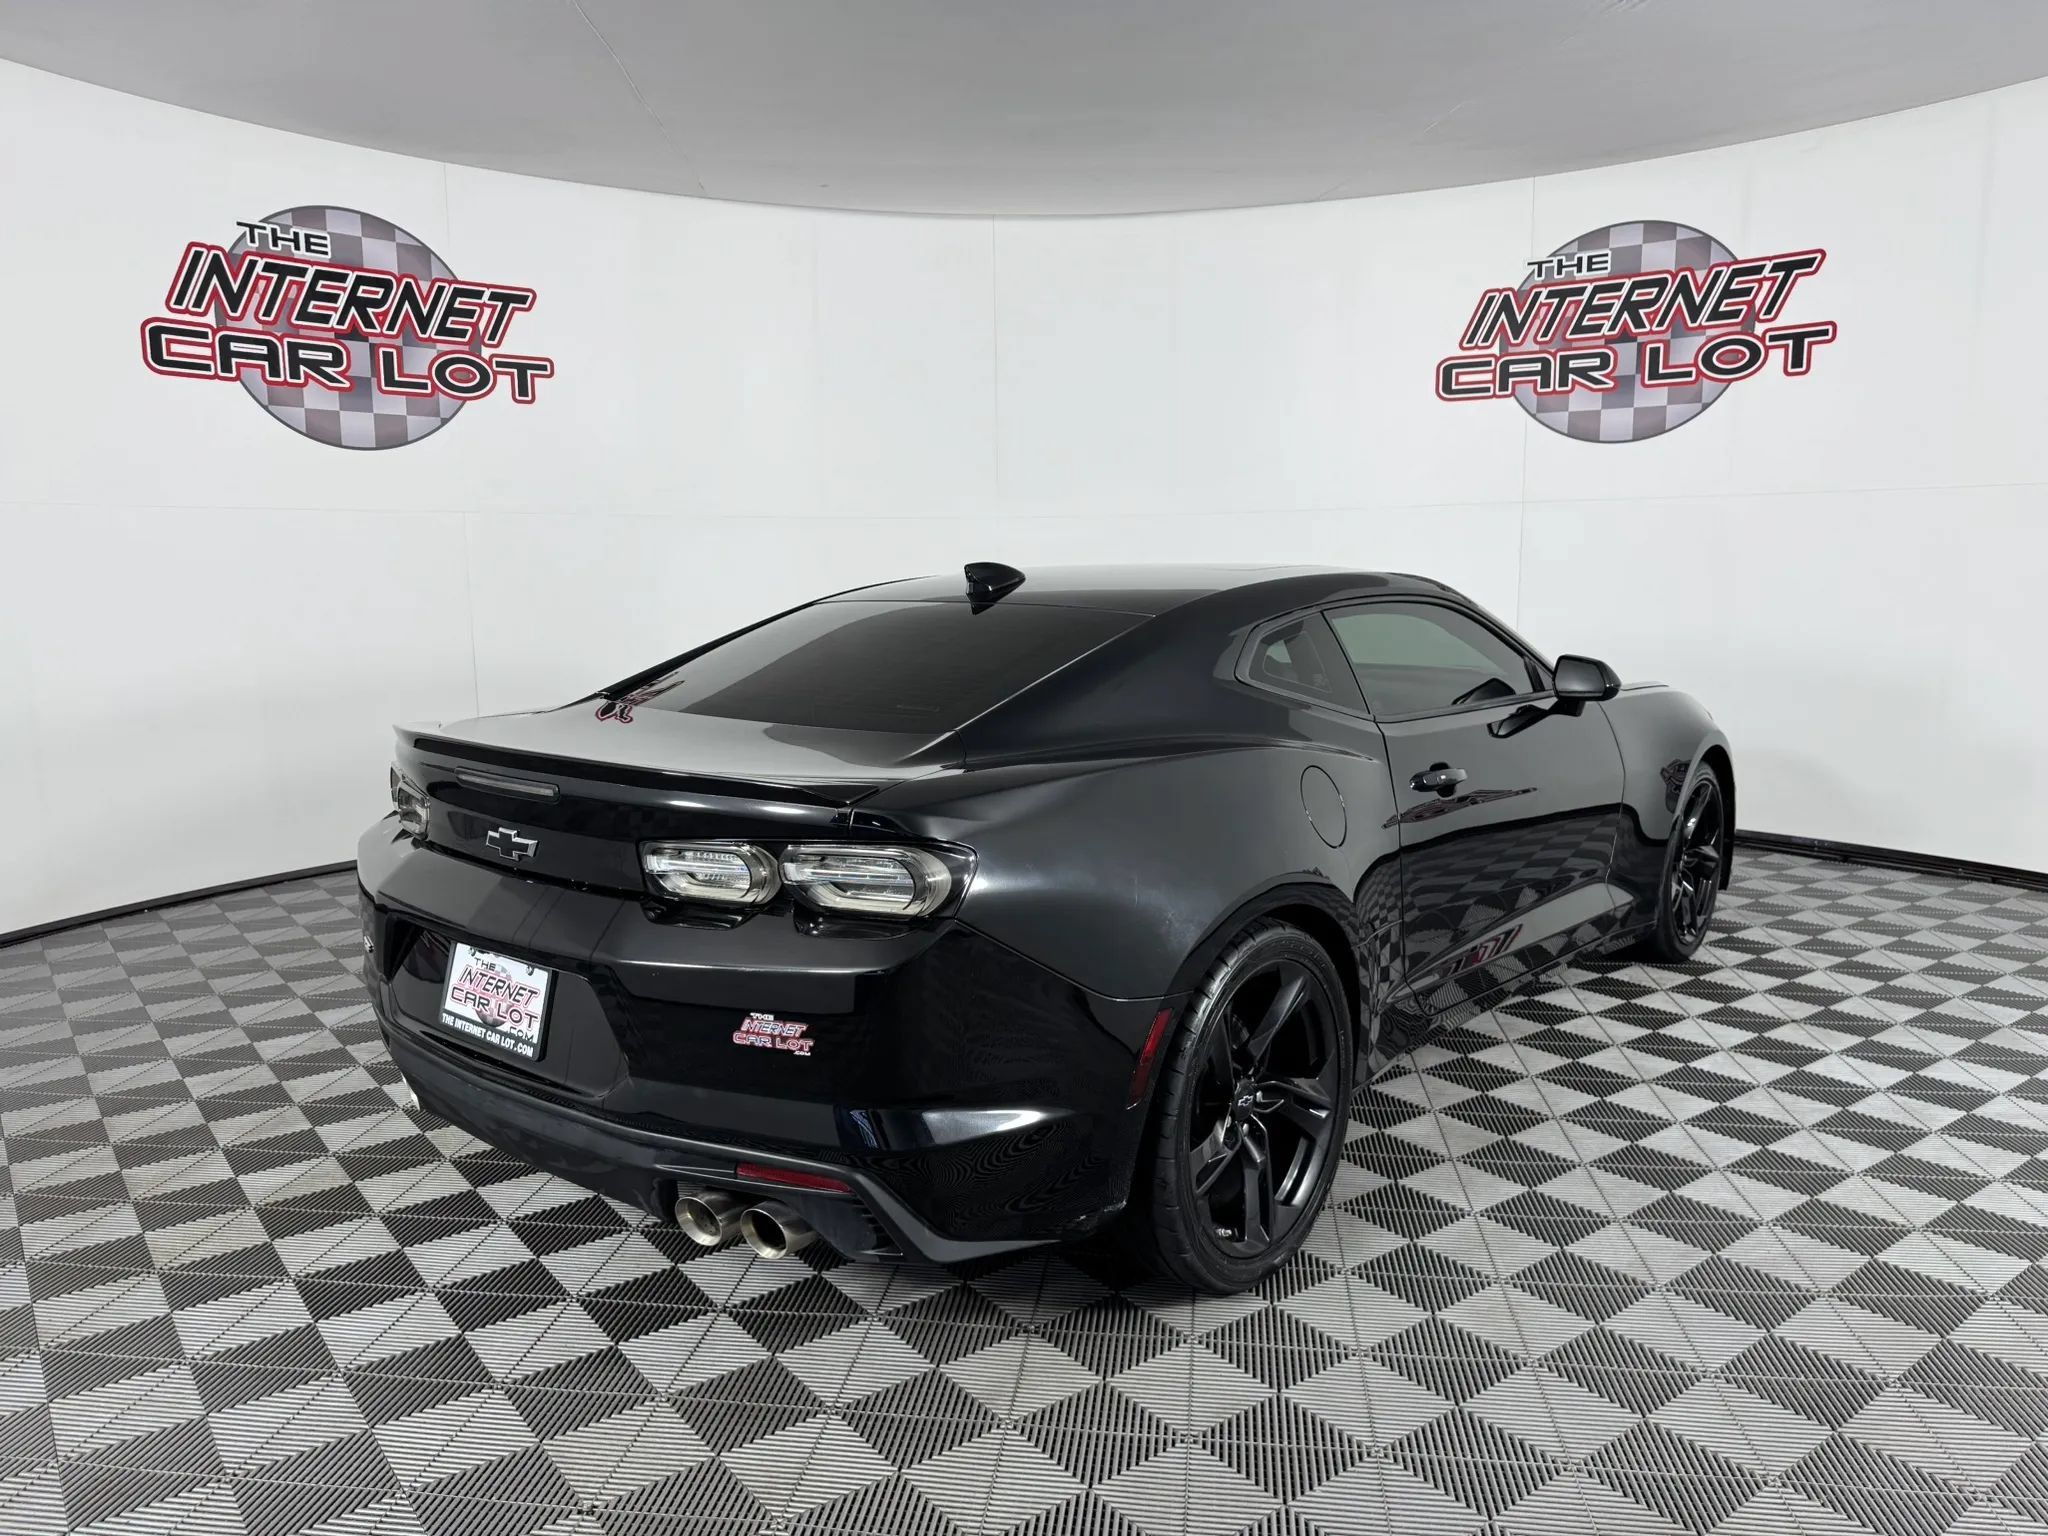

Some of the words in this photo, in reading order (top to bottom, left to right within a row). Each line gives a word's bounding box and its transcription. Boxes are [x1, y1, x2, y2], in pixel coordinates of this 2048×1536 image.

[235, 219, 331, 257] THE
[1526, 251, 1611, 279] THE
[167, 242, 537, 348] INTERNET
[1461, 250, 1825, 349] INTERNET
[143, 319, 353, 391] CAR
[378, 346, 552, 402] LOT
[1438, 348, 1616, 398] CAR
[1643, 324, 1835, 386] LOT
[474, 957, 497, 971] THE
[459, 966, 539, 1006] INTERNET
[451, 986, 491, 1012] CAR
[496, 1002, 539, 1029] LOT
[740, 1016, 808, 1037] INTERNET
[442, 1013, 455, 1026] THE
[454, 1017, 487, 1039] INTERNET
[486, 1030, 501, 1045] CAR
[732, 1030, 773, 1048] CAR
[775, 1037, 815, 1051] LOT
